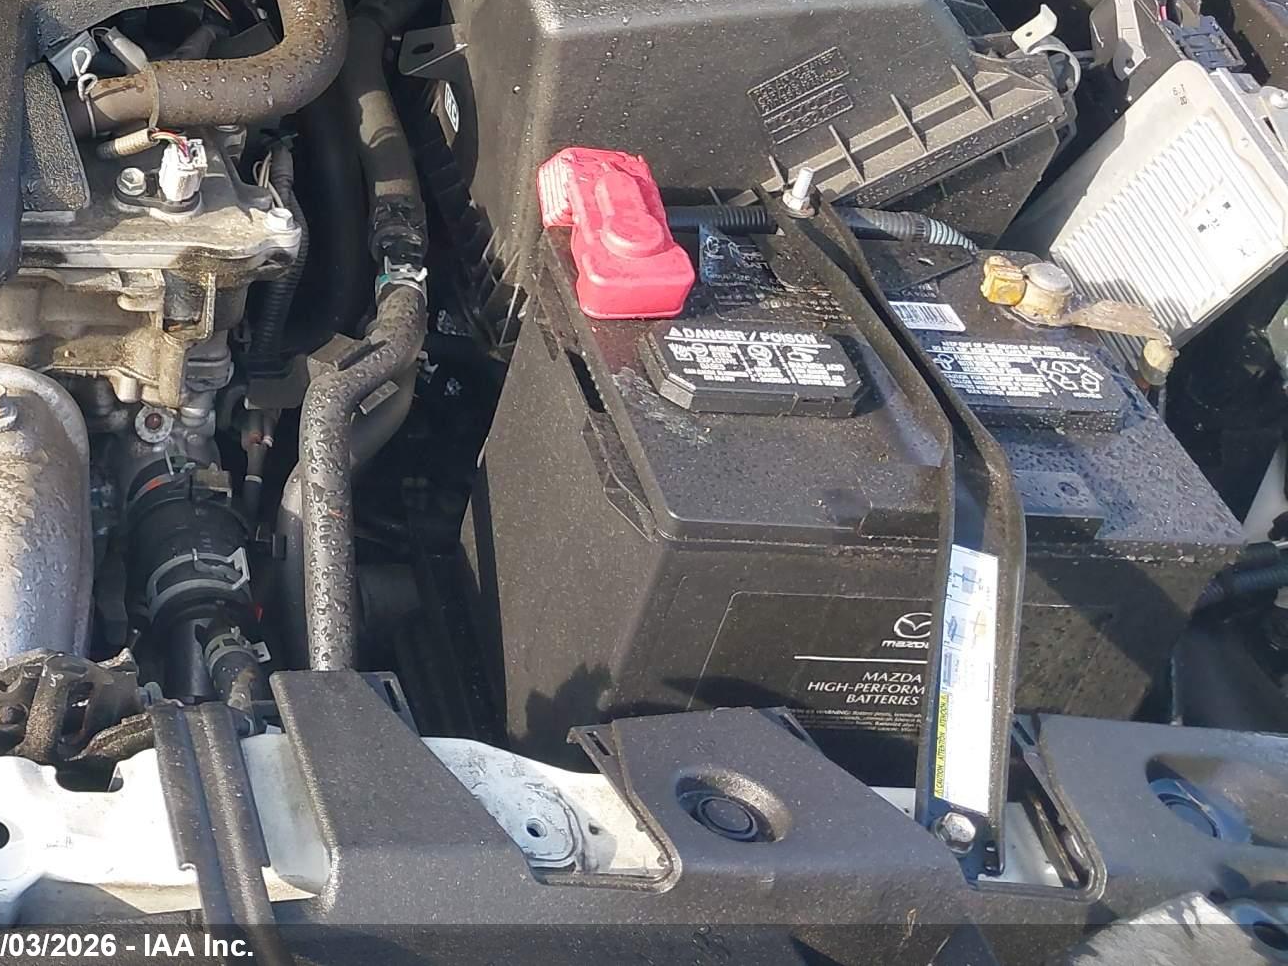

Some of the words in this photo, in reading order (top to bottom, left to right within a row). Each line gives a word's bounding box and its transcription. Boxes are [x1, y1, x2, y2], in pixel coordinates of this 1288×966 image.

[682, 328, 747, 341] DANGER
[760, 332, 818, 345] POISON
[881, 640, 929, 649] mazd
[862, 672, 922, 683] MAZDA
[807, 681, 925, 695] HIGH-PERFORM
[846, 694, 920, 706] BATTERIES
